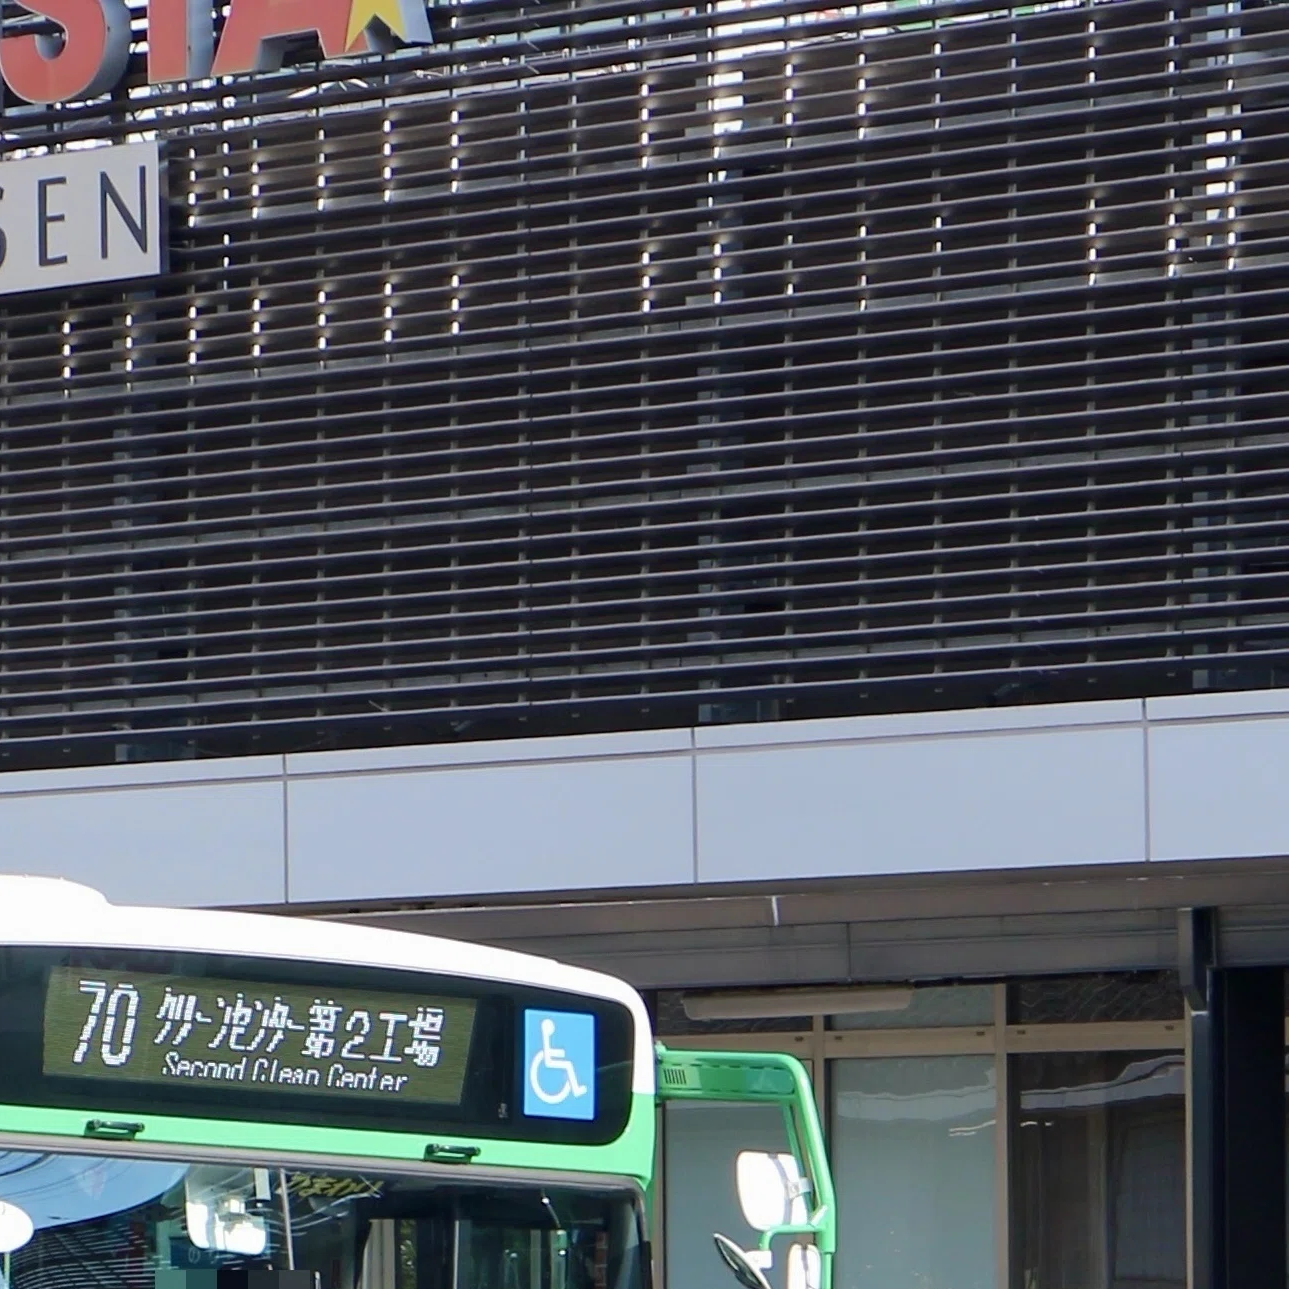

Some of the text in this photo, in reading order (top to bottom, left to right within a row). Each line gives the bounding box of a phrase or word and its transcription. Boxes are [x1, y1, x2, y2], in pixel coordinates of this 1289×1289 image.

[72, 979, 141, 1067] 70
[161, 1051, 409, 1093] Second Clean Center
